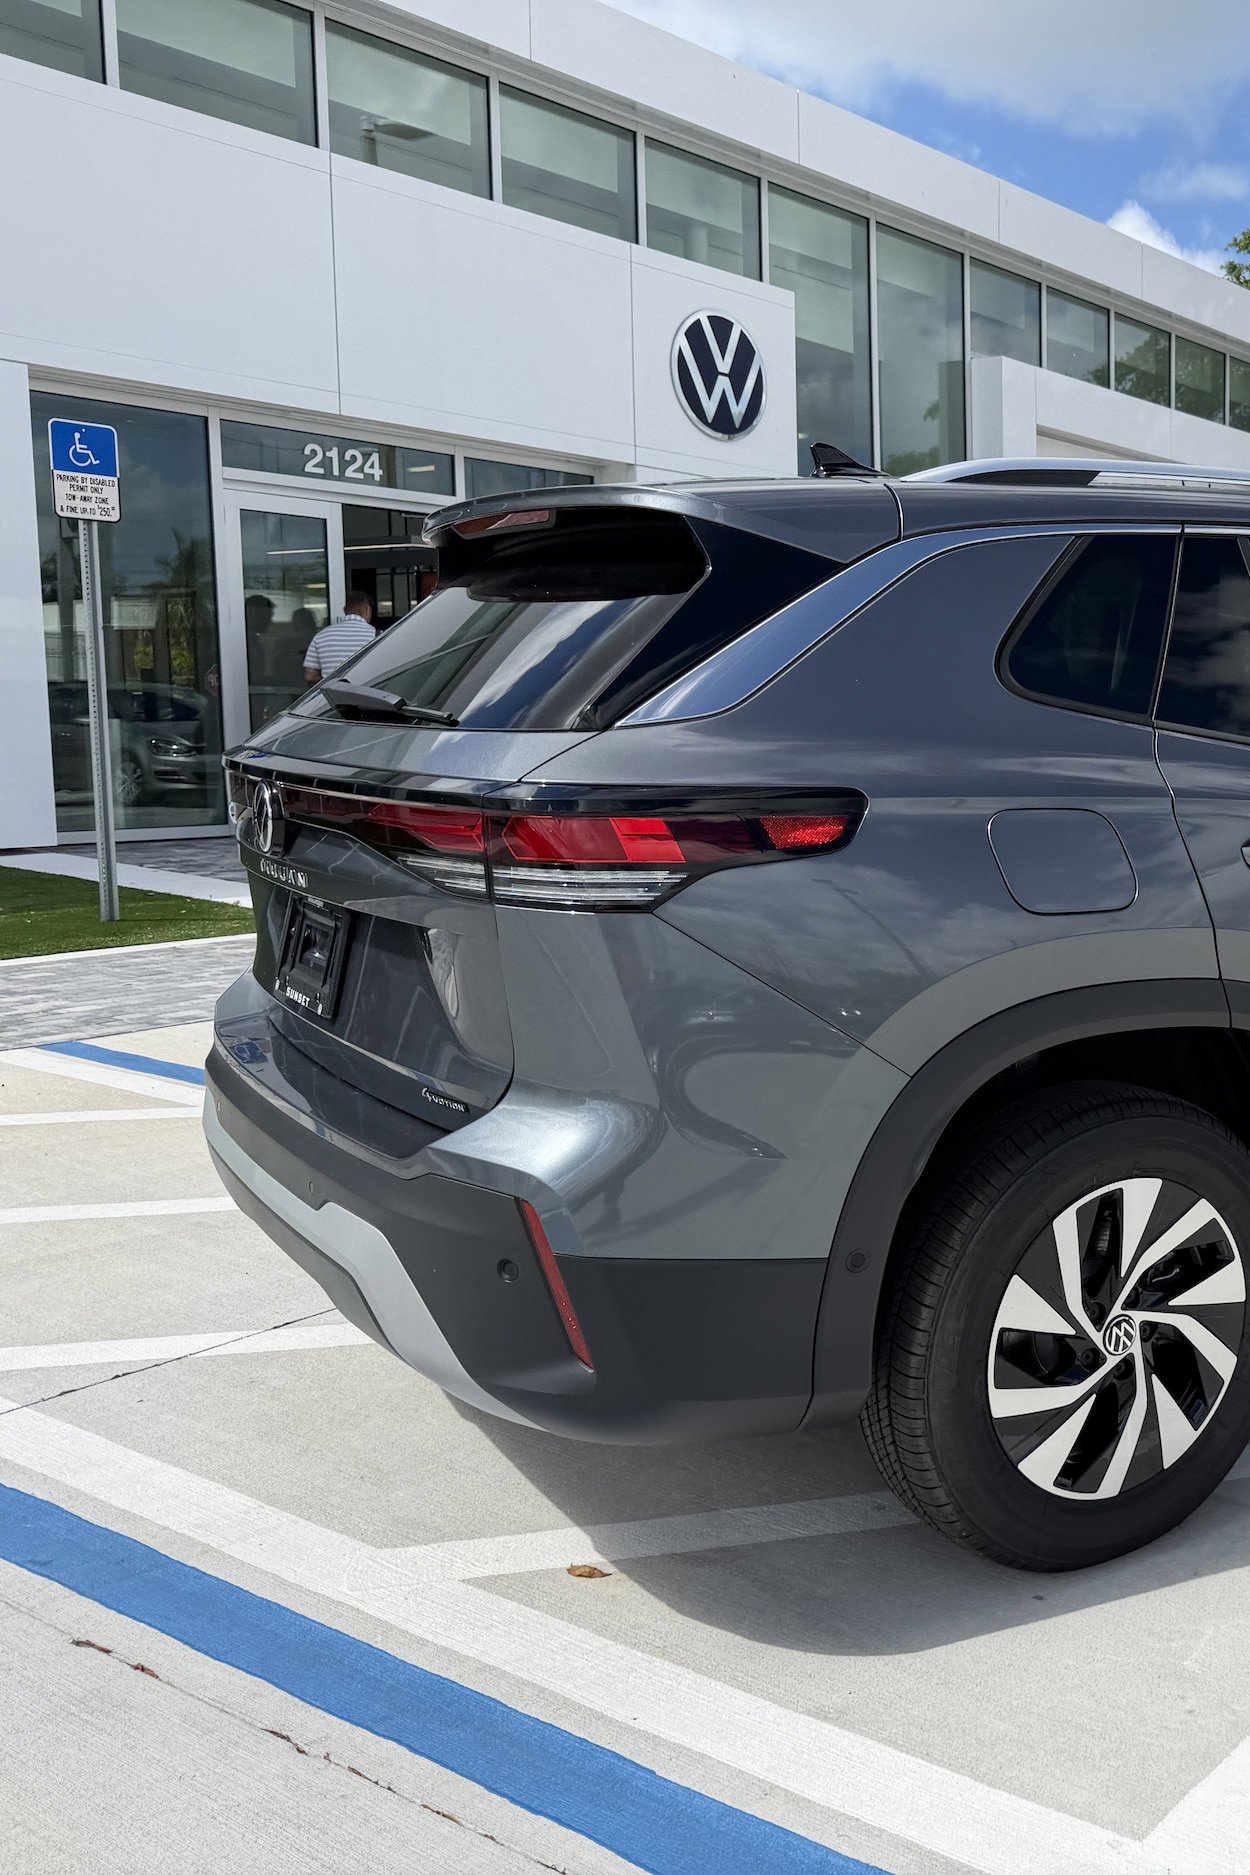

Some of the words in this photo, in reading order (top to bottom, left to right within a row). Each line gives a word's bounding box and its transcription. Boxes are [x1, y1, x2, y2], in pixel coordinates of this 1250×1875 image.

[675, 312, 765, 432] VW
[303, 443, 384, 482] 2124
[56, 474, 79, 483] PARKING
[90, 478, 116, 487] DISABLED
[69, 484, 88, 492] PERMIT
[90, 486, 104, 494] ONLY
[66, 505, 79, 514] FINE
[89, 507, 96, 515] TO
[95, 496, 109, 505] ZONE
[285, 986, 311, 1008] SUNSET
[421, 1087, 466, 1112] 4MOTION
[1106, 1316, 1136, 1354] VW
